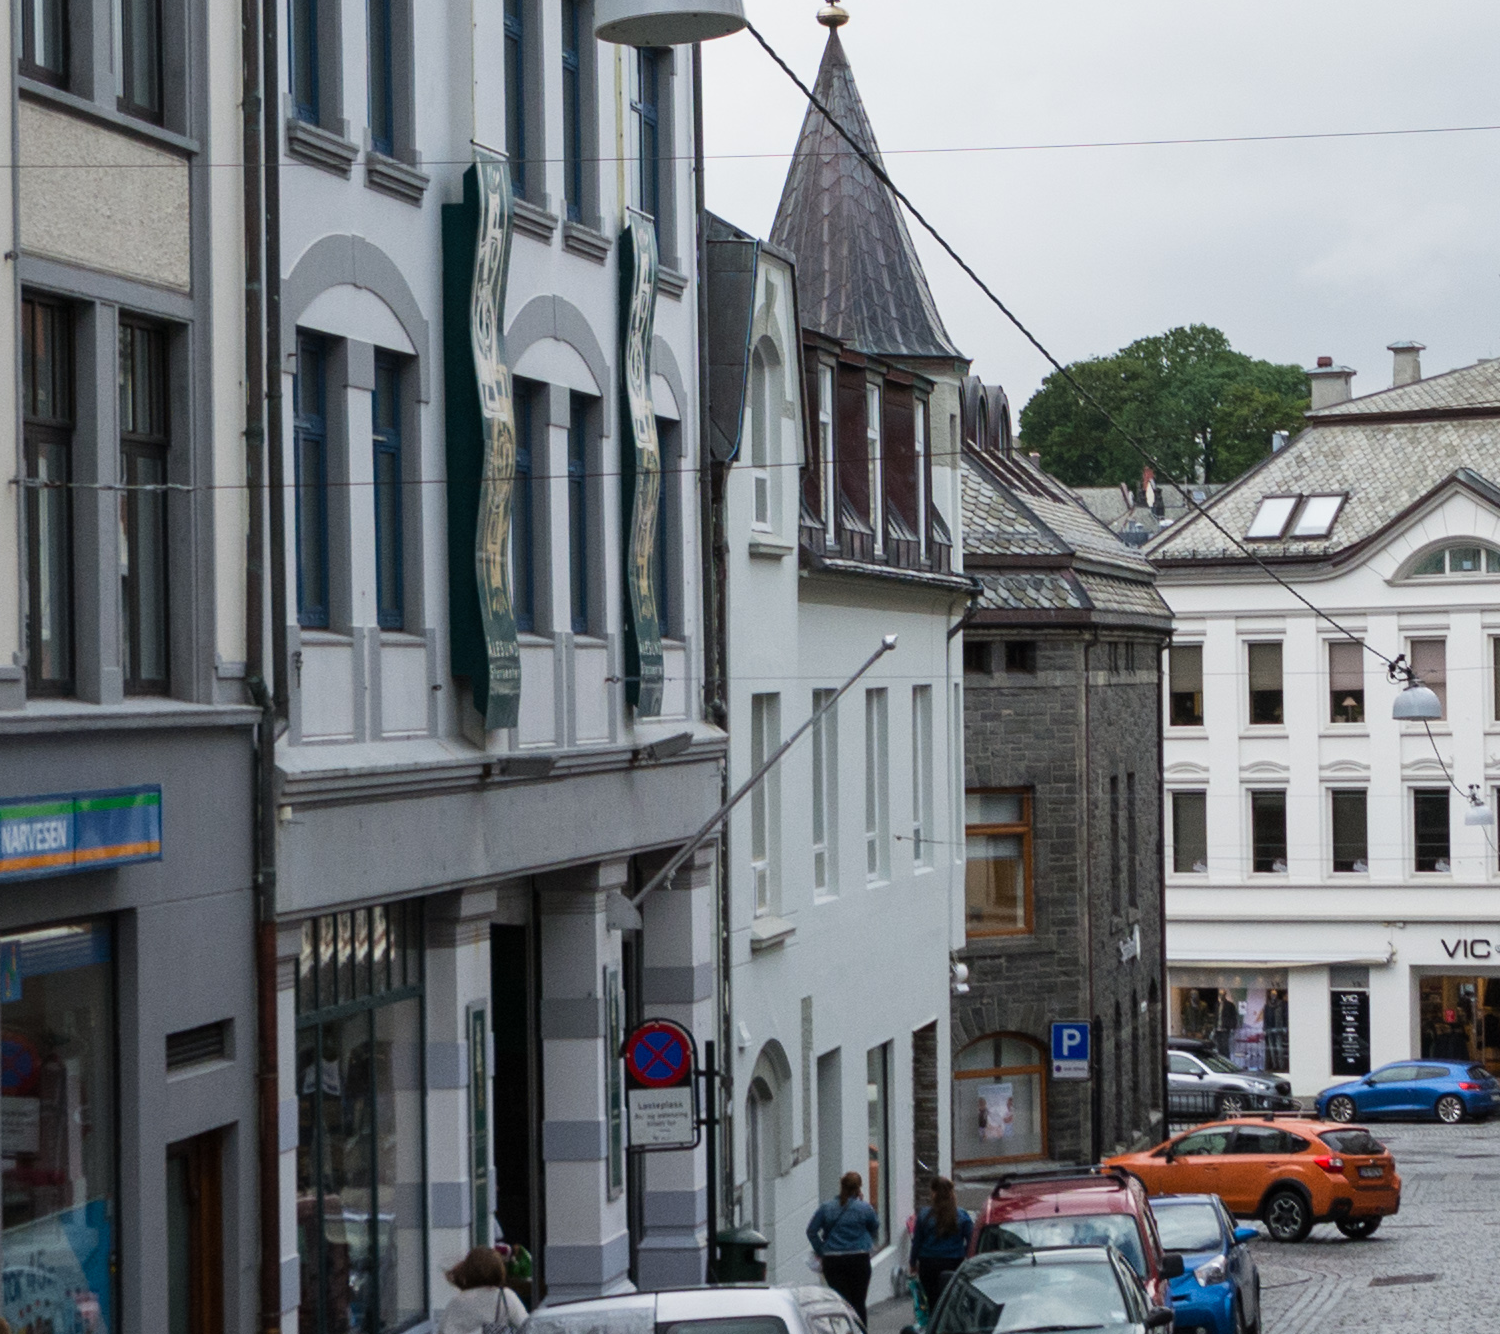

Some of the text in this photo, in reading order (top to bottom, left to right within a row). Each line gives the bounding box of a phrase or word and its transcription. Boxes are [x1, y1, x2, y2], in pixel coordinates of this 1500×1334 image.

[0, 819, 67, 854] NARVESEN
[1441, 939, 1491, 959] VIC
[1062, 1028, 1081, 1056] P
